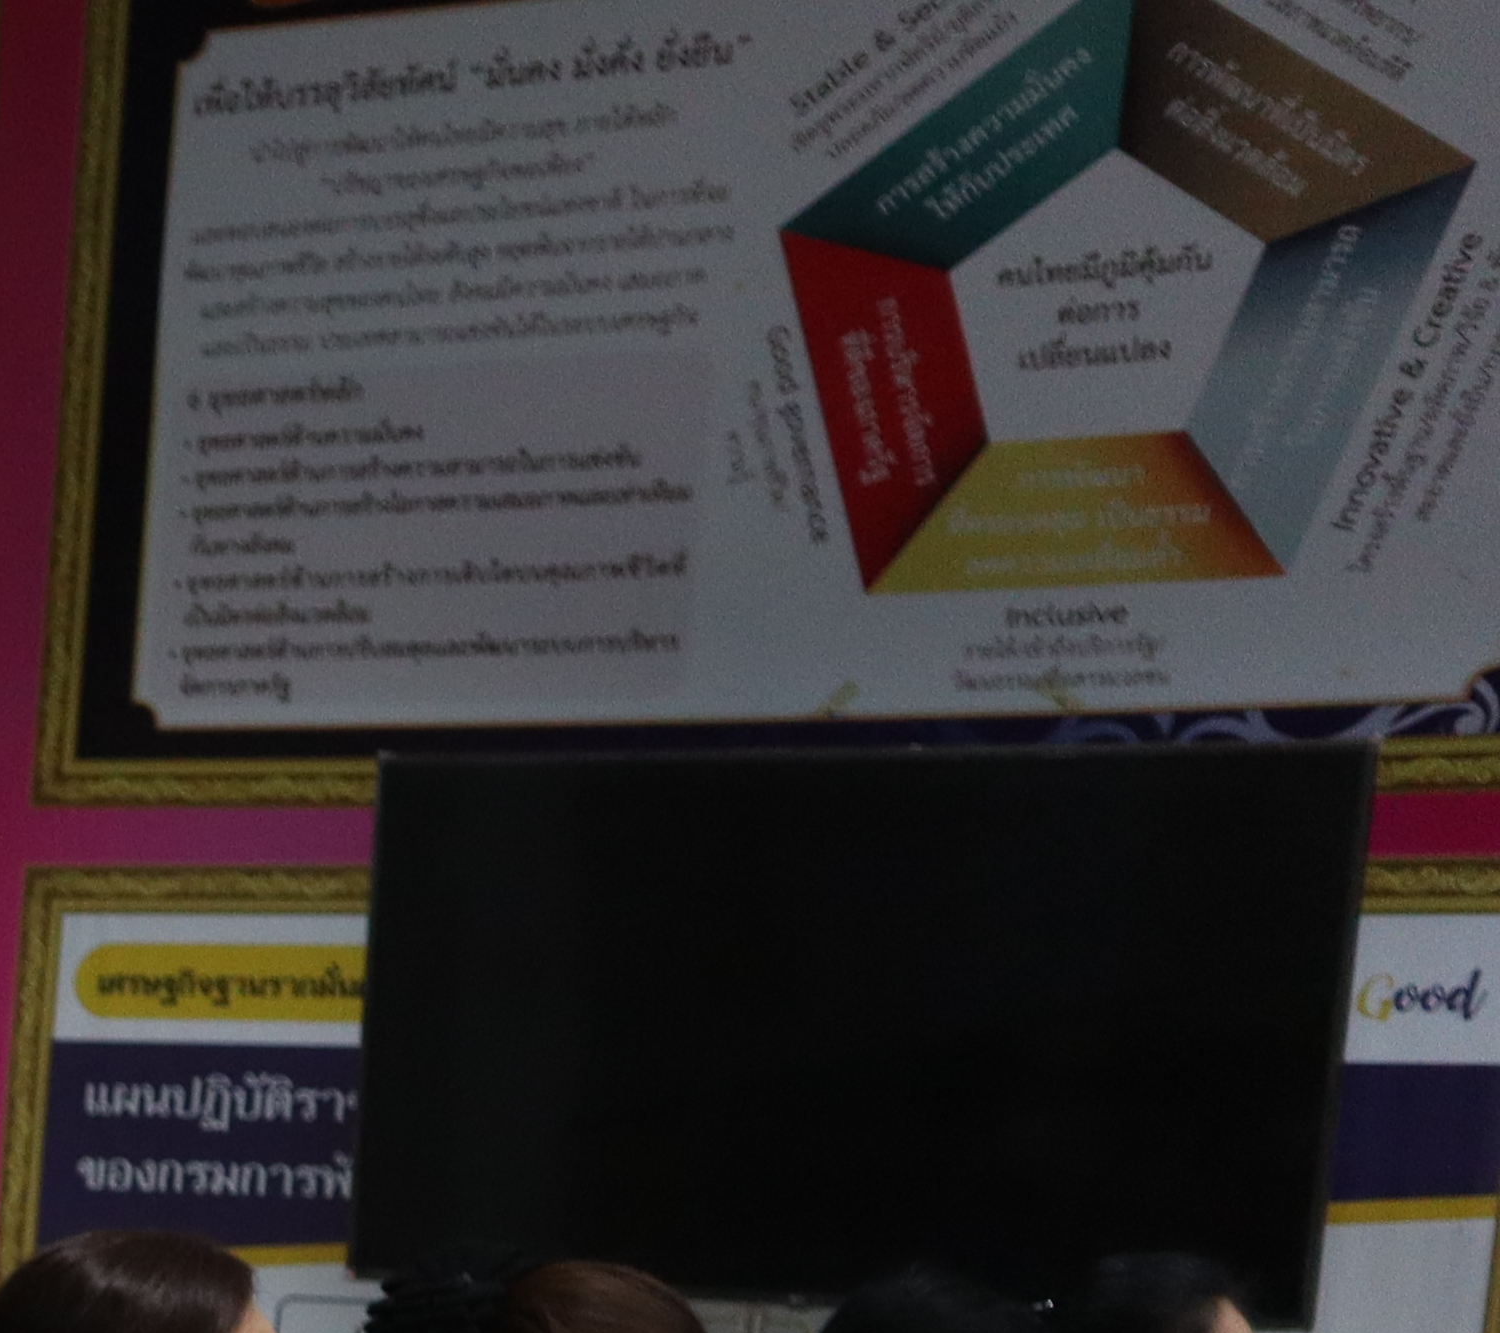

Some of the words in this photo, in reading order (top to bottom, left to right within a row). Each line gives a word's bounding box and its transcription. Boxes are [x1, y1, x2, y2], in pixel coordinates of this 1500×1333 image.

[1331, 382, 1406, 532] Innovative
[1412, 231, 1483, 350] Creative
[1357, 969, 1486, 1022] Good
[84, 1073, 357, 1133] แผนปฏิบัติรา
